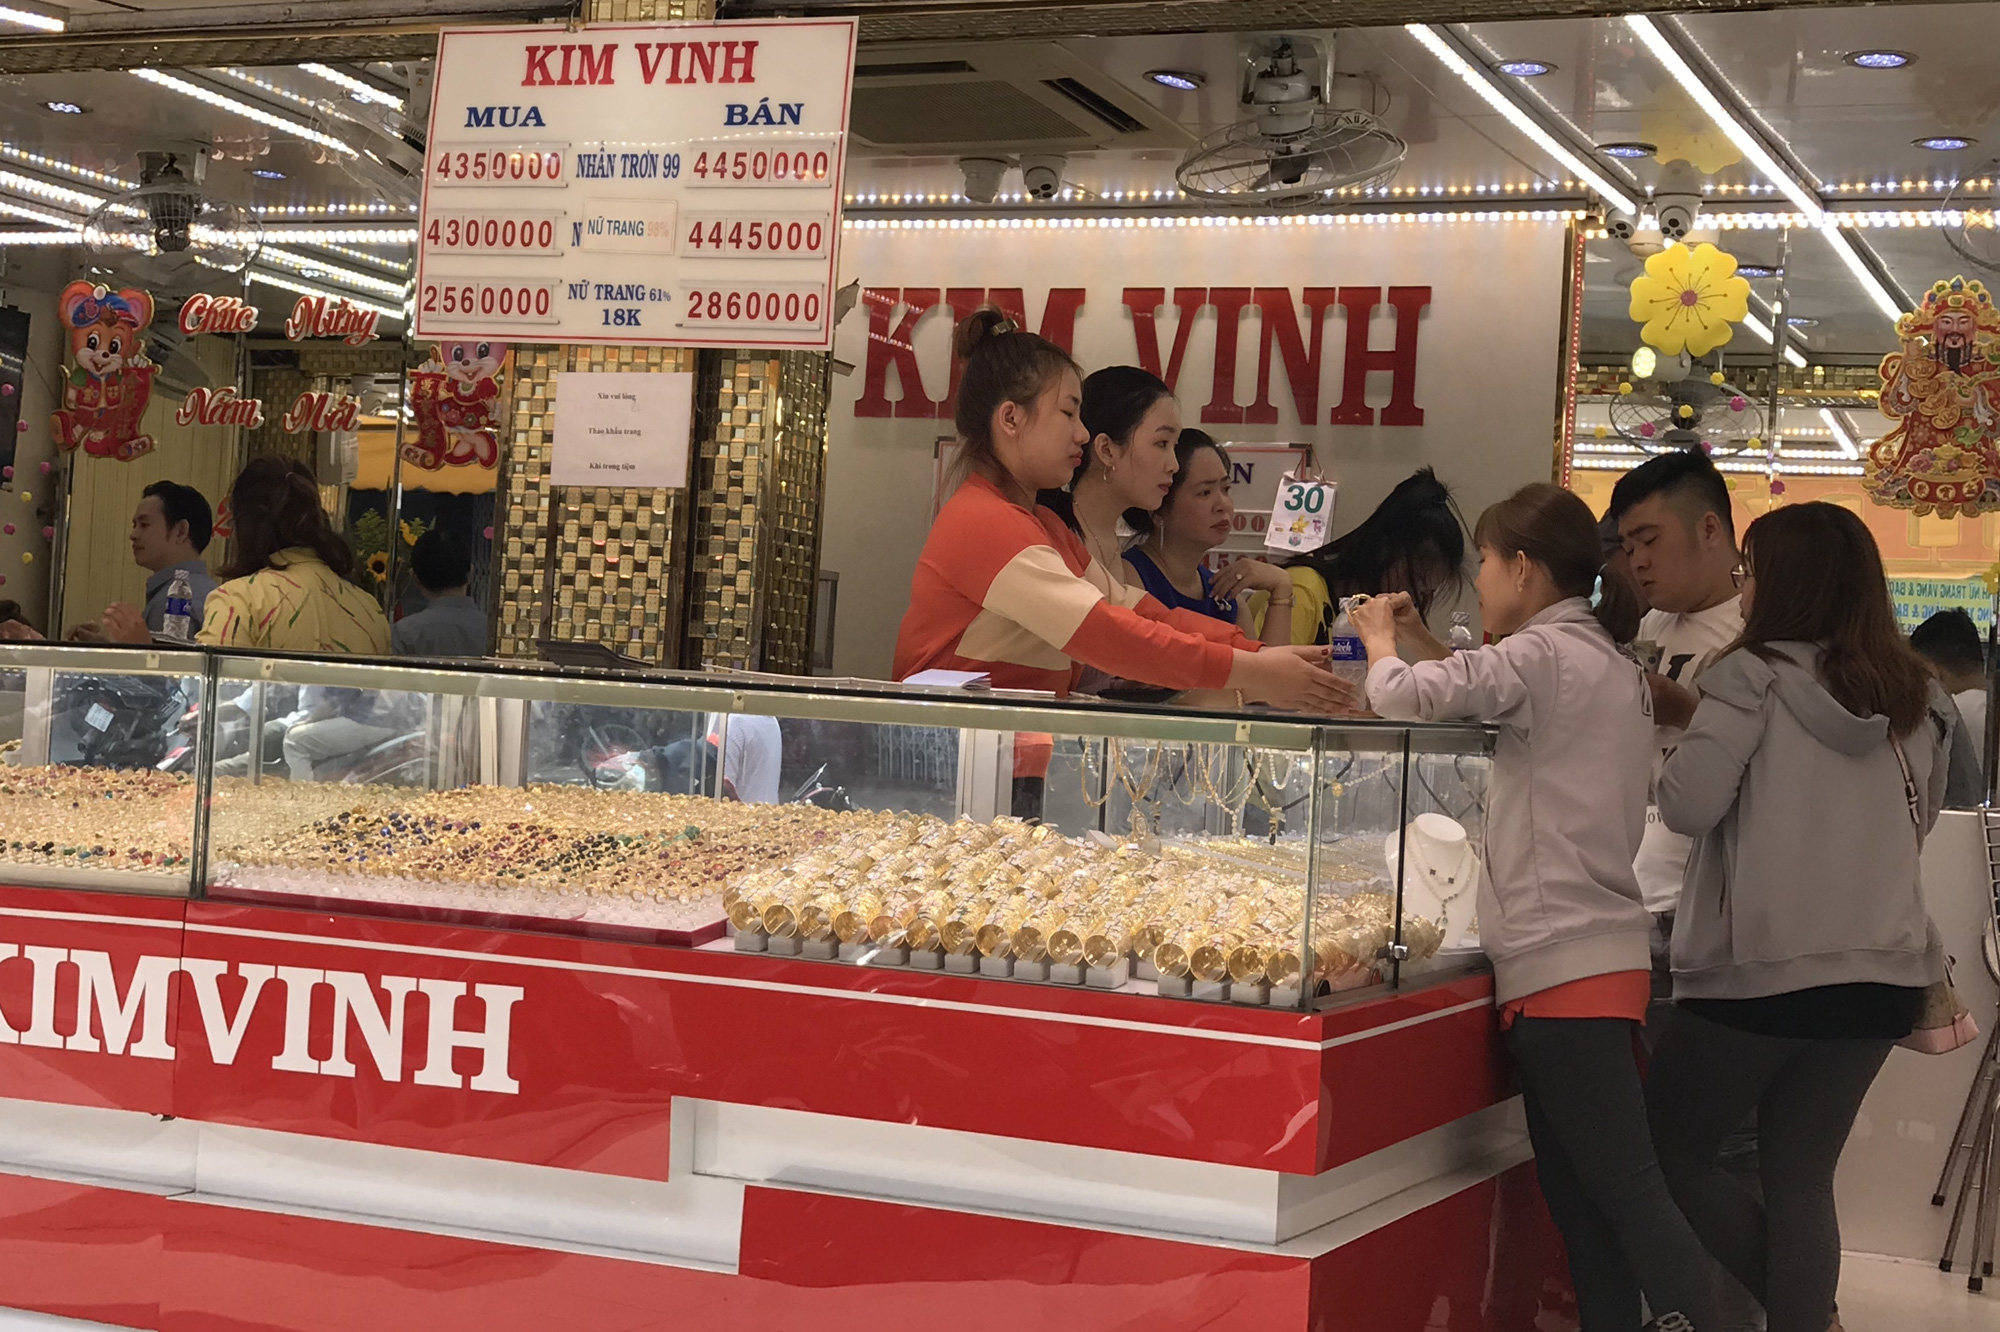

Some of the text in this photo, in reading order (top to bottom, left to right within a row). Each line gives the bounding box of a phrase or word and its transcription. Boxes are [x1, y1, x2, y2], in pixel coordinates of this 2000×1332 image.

[521, 40, 759, 87] KIM VINH
[464, 105, 546, 128] MUA
[723, 97, 804, 126] BÁN
[437, 150, 561, 180] 4350000
[662, 153, 680, 178] 99
[693, 150, 828, 180] 4450000
[427, 218, 553, 248] 4300000
[607, 220, 644, 236] TRANG
[688, 220, 821, 251] 4445000
[424, 285, 550, 315] 2560000
[594, 284, 646, 301] TRANG
[649, 288, 671, 301] 61%
[688, 290, 819, 322] 2860000
[178, 293, 258, 336] Chúc
[602, 308, 642, 326] 18K
[1122, 286, 1432, 426] VINH
[1284, 485, 1324, 513] 30
